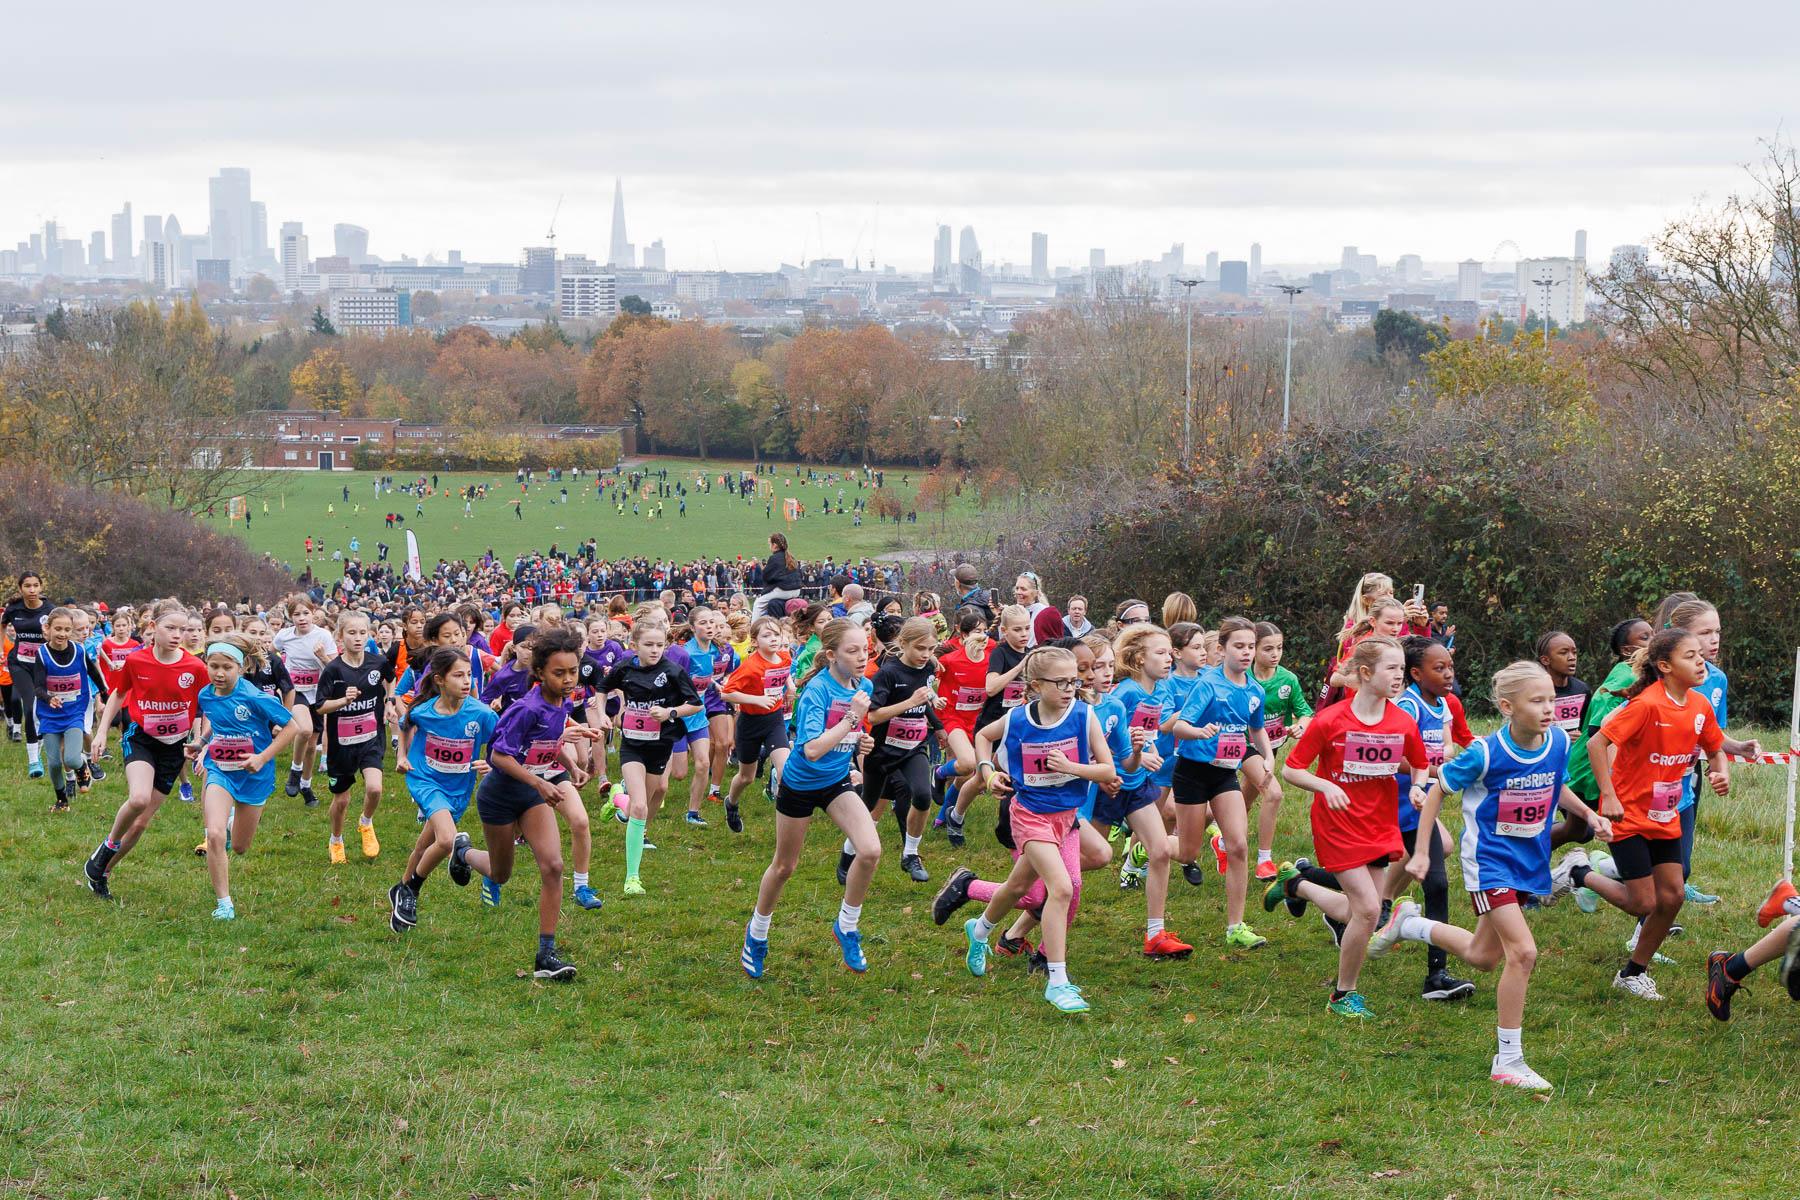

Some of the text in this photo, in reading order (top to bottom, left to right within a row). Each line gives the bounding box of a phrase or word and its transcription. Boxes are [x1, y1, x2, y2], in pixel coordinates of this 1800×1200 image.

[294, 676, 314, 685] 219
[53, 683, 75, 692] 192
[336, 696, 378, 712] ARNET
[966, 695, 982, 703] 84
[137, 700, 192, 711] HARINGEY
[1561, 707, 1578, 719] 83
[157, 723, 178, 735] 96
[354, 724, 363, 734] 5
[635, 719, 645, 730] 3
[895, 728, 922, 740] 207
[1267, 727, 1283, 740] 46
[433, 748, 464, 763] 190
[1355, 746, 1393, 762] 100
[1506, 772, 1556, 790] REDBRIDGE
[1513, 804, 1546, 823] 195
